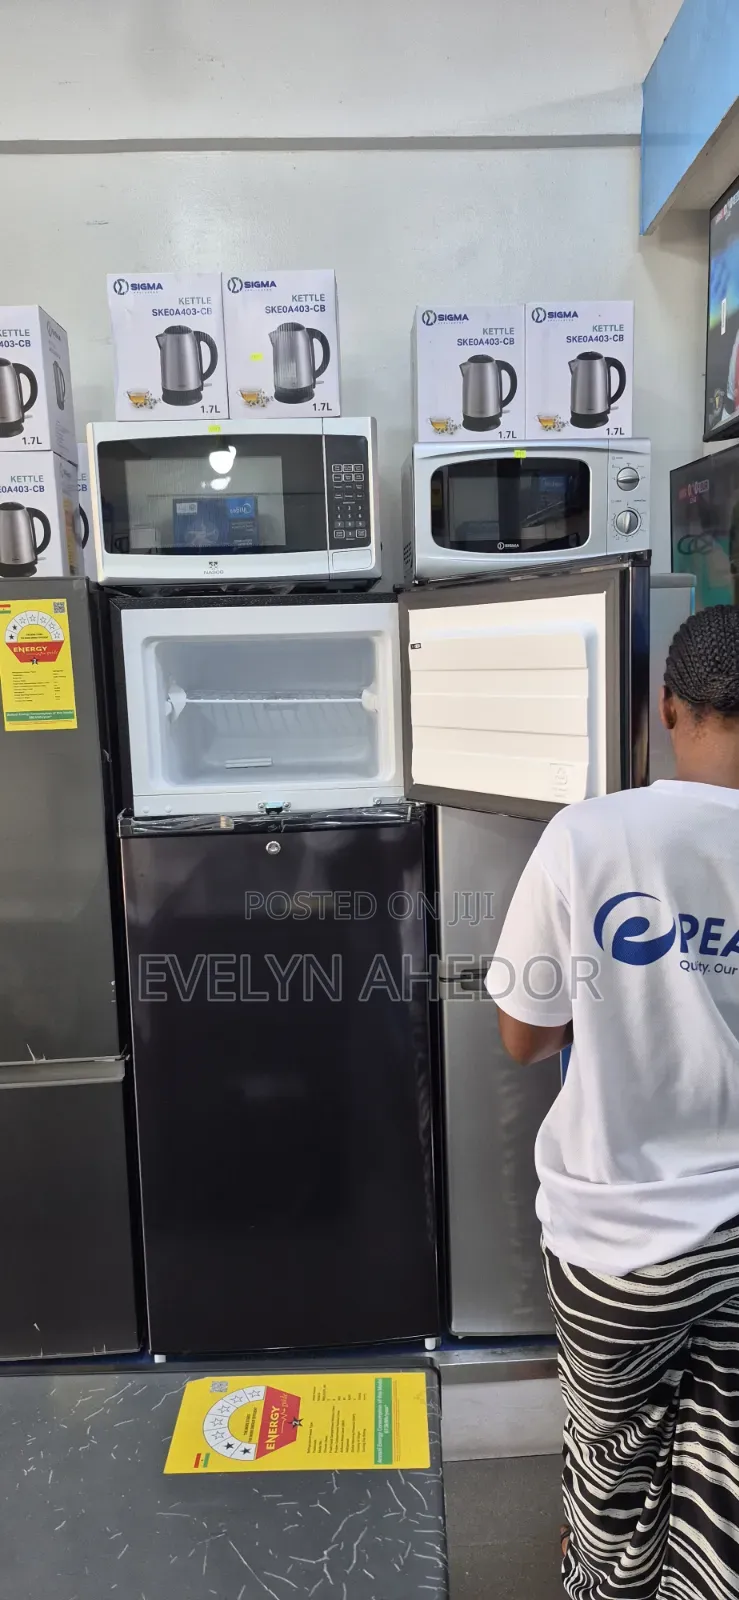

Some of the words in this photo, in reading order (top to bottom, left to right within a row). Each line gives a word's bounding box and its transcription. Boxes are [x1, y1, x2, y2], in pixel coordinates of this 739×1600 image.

[130, 282, 164, 291] SIGMA
[244, 280, 278, 289] SIGMA
[178, 297, 213, 305] KETTLE
[291, 294, 326, 303] KETTLE
[438, 314, 470, 323] SIGMA
[547, 311, 579, 320] SIGMA
[482, 327, 515, 336] KETTLE
[592, 324, 625, 333] KETTLE
[200, 404, 221, 414] 1.7L
[312, 402, 333, 412] 1.7L
[498, 430, 518, 439] 1.7L
[606, 427, 626, 437] 1.7L
[22, 436, 43, 445] 1.7L
[10, 474, 45, 483] KETTLE
[13, 646, 48, 654] ENERGY
[714, 963, 738, 976] Our
[264, 1406, 280, 1450] ENERGY
